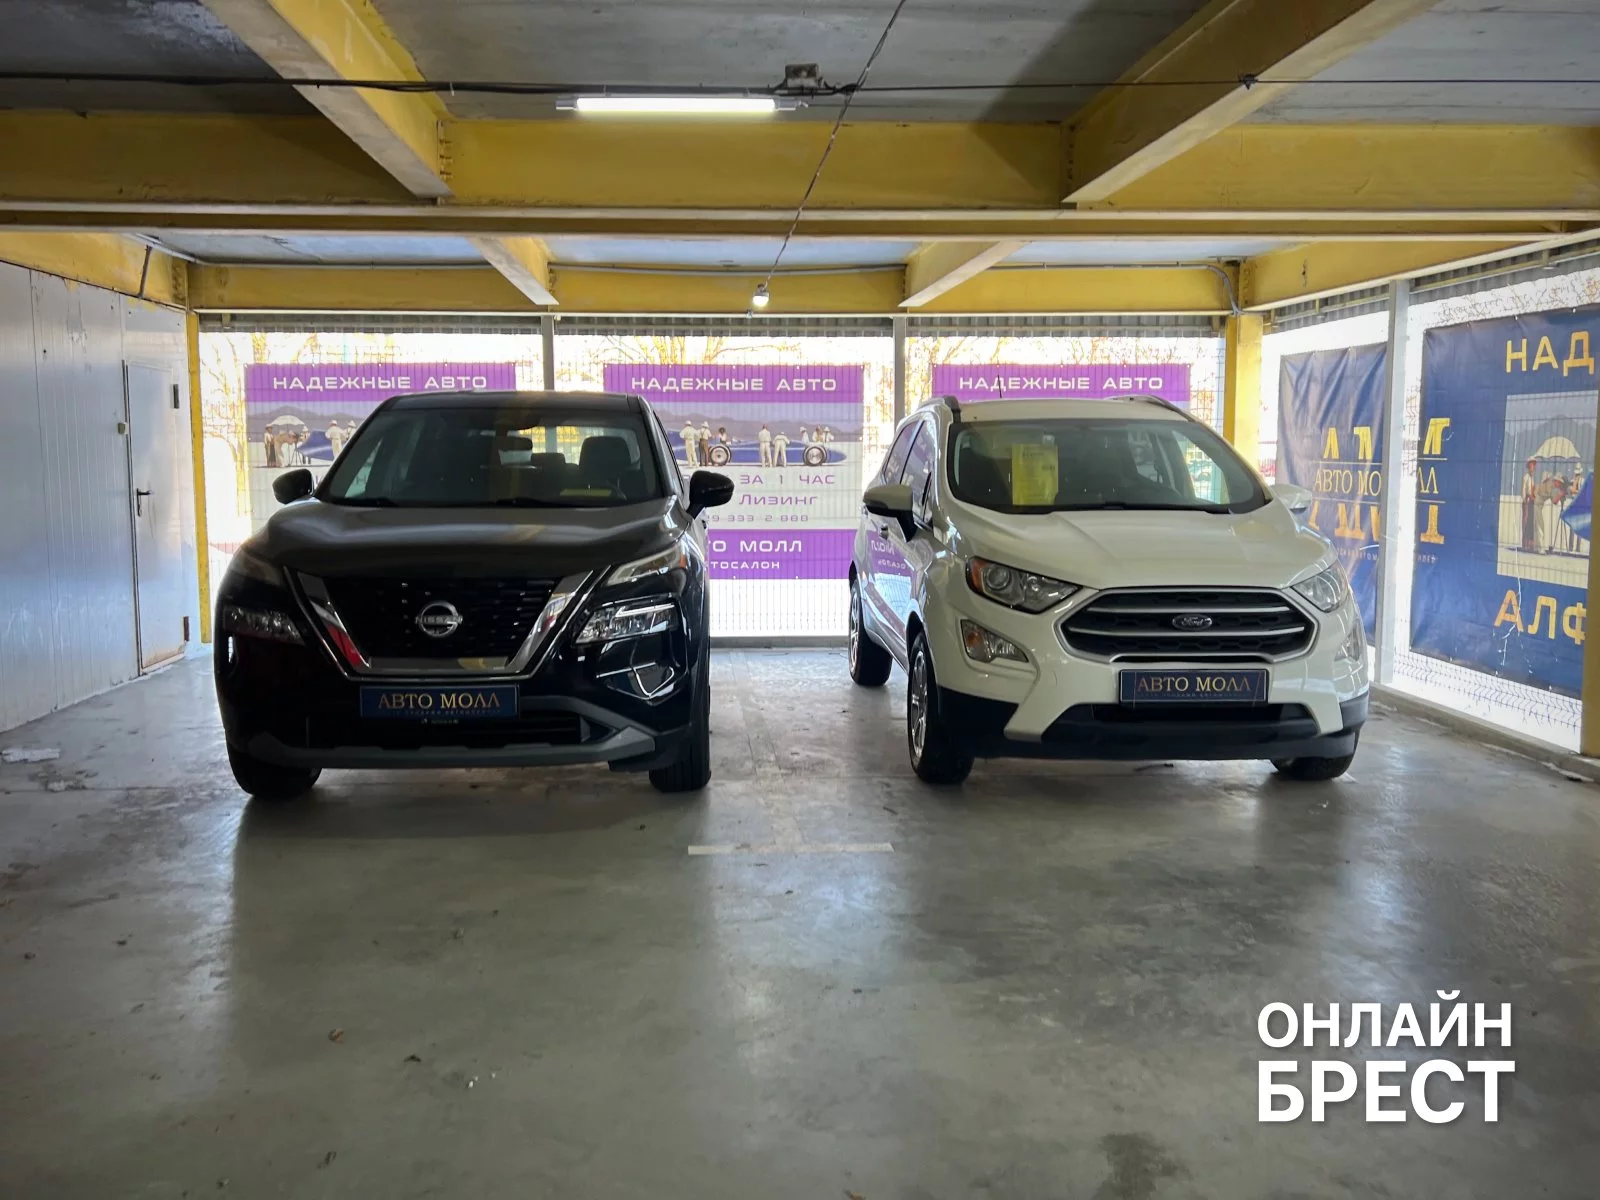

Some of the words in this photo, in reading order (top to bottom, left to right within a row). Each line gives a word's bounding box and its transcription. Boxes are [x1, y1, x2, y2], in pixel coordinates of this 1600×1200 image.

[1505, 331, 1595, 377] НАД
[273, 376, 411, 392] НАДЕЖНЫЕ
[424, 376, 487, 389] АВТО
[631, 377, 764, 393] НАДЕЖНЫЕ
[776, 378, 837, 391] АВТО
[959, 377, 1090, 392] НАДЕЖНЫЕ
[1102, 377, 1163, 390] АВТО
[740, 474, 764, 485] ЗА
[778, 474, 784, 485] 1
[799, 474, 836, 485] ЧАС
[1312, 469, 1353, 494] АВТО
[739, 494, 818, 506] Лизинг
[727, 514, 755, 522] 333
[764, 514, 773, 522] 2
[740, 540, 802, 553] МОЛЛ
[710, 561, 780, 570] ТОСАЛОН
[1138, 677, 1189, 692] АВТО
[1195, 677, 1250, 692] МОЛЛ
[378, 693, 433, 709] АВТО
[440, 693, 500, 709] МОЛЛ
